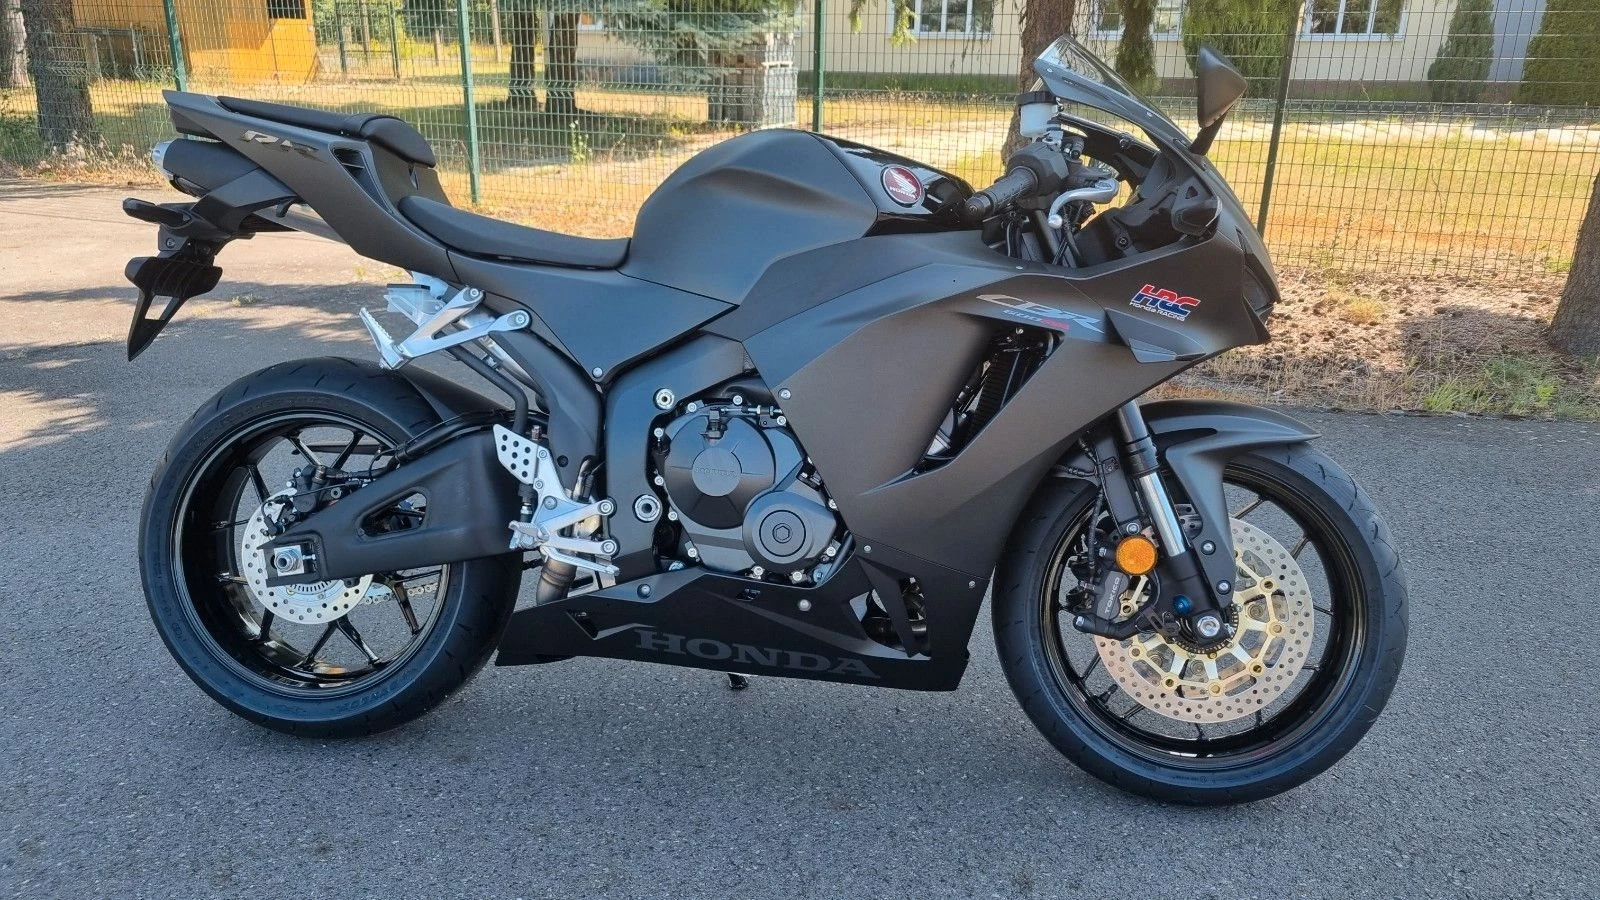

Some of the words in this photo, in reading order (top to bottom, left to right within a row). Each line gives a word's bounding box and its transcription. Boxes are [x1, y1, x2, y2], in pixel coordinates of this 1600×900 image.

[889, 186, 917, 199] HONDA
[975, 294, 1104, 334] CBR
[1130, 284, 1201, 318] HRC
[1157, 309, 1185, 321] RACING
[1105, 577, 1120, 614] TOKICO
[634, 629, 880, 678] HONDA
